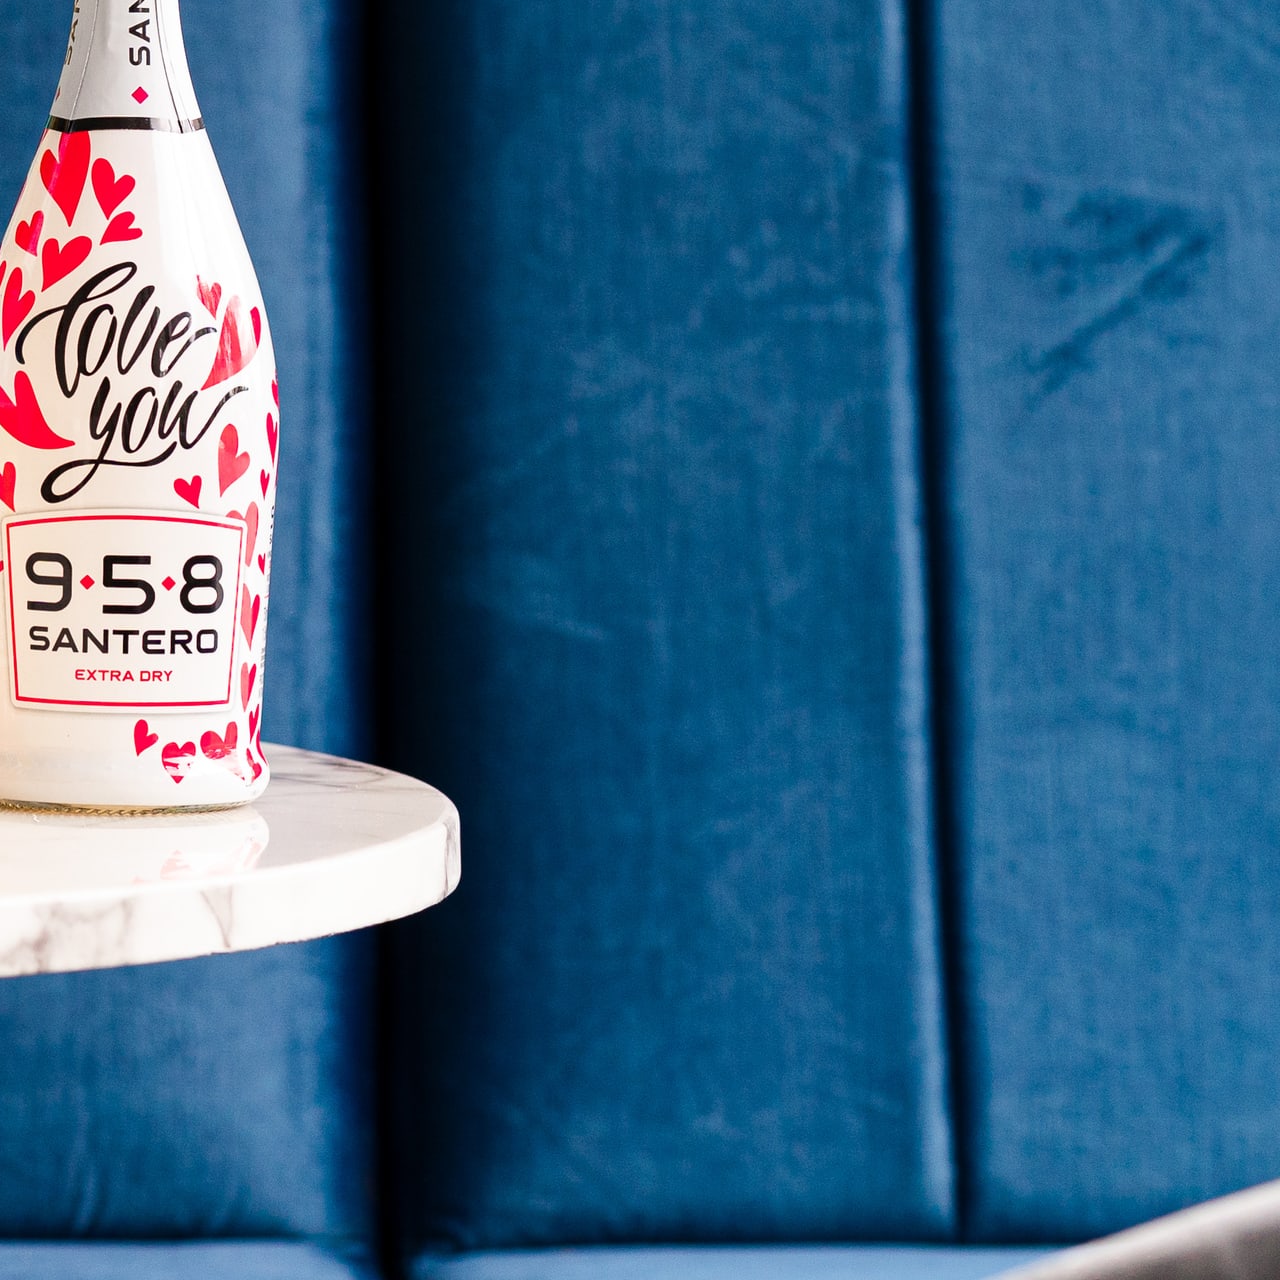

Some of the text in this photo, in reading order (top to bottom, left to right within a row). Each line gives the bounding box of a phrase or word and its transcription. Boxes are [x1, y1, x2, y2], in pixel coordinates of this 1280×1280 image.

[41, 376, 250, 505] you
[28, 625, 219, 655] SANTERO
[74, 668, 174, 683] EXTRA DRY
